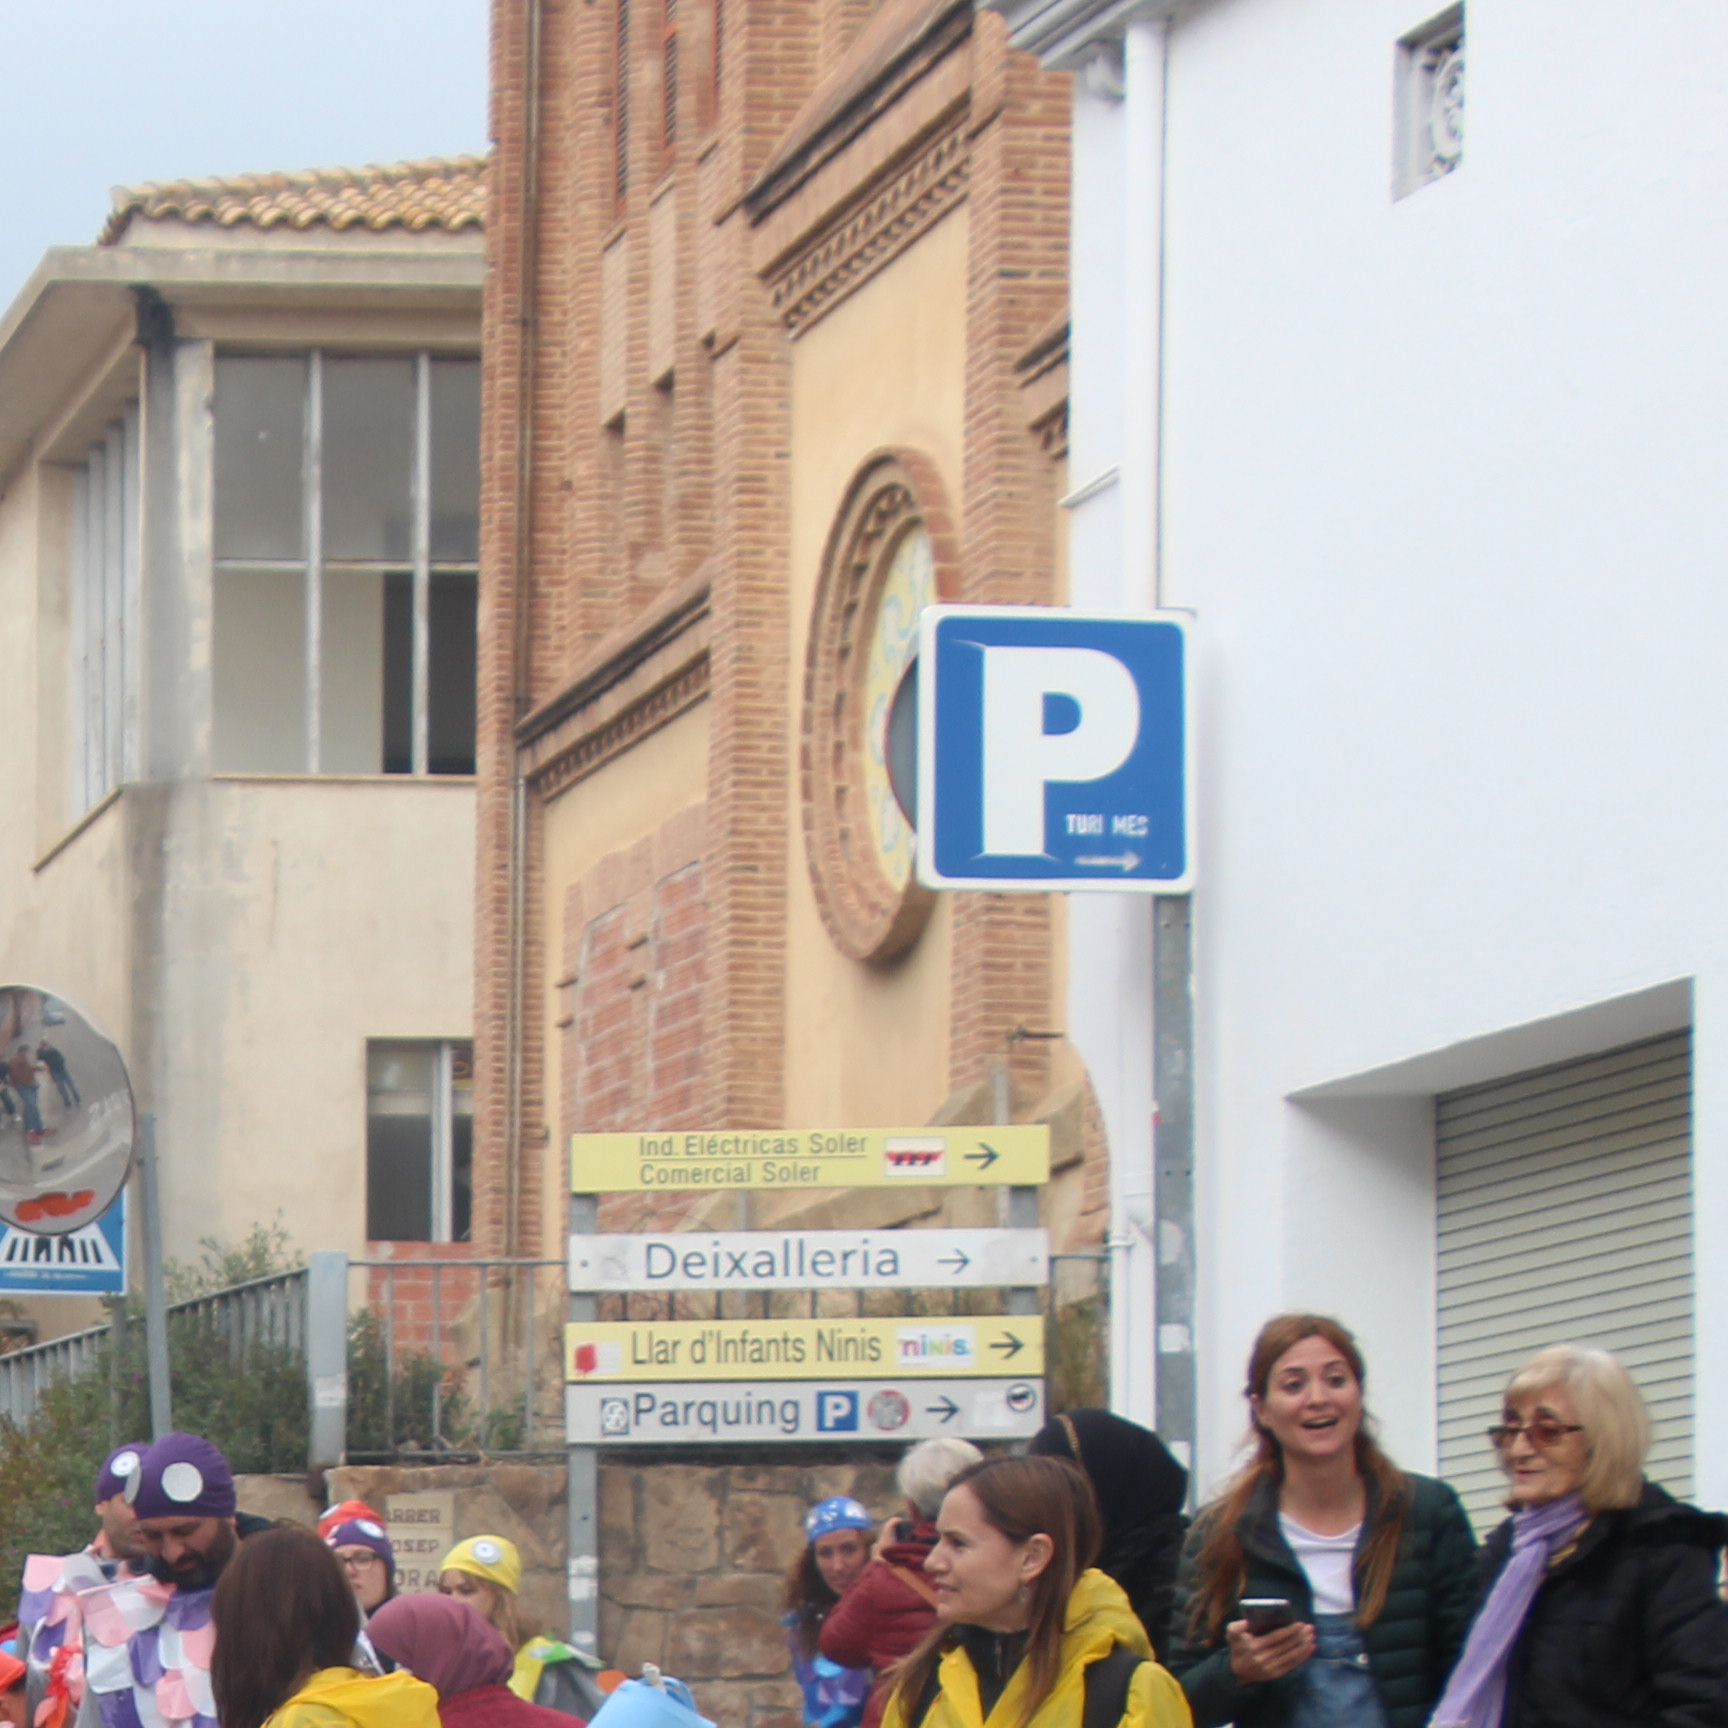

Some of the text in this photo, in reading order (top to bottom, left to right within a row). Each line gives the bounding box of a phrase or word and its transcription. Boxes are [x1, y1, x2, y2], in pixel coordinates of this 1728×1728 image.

[983, 646, 1141, 855] P
[1112, 814, 1149, 836] MES
[639, 1132, 867, 1156] Ind. Eléctricas Soler
[640, 1161, 820, 1185] Comercial Soler
[645, 1237, 899, 1279] Deixalleria
[632, 1328, 882, 1365] Llar d'Infants Ninis
[633, 1391, 851, 1434] Parquing P
[385, 1508, 441, 1524] ARRER
[392, 1539, 440, 1553] OSEP
[394, 1569, 439, 1587] ORA
